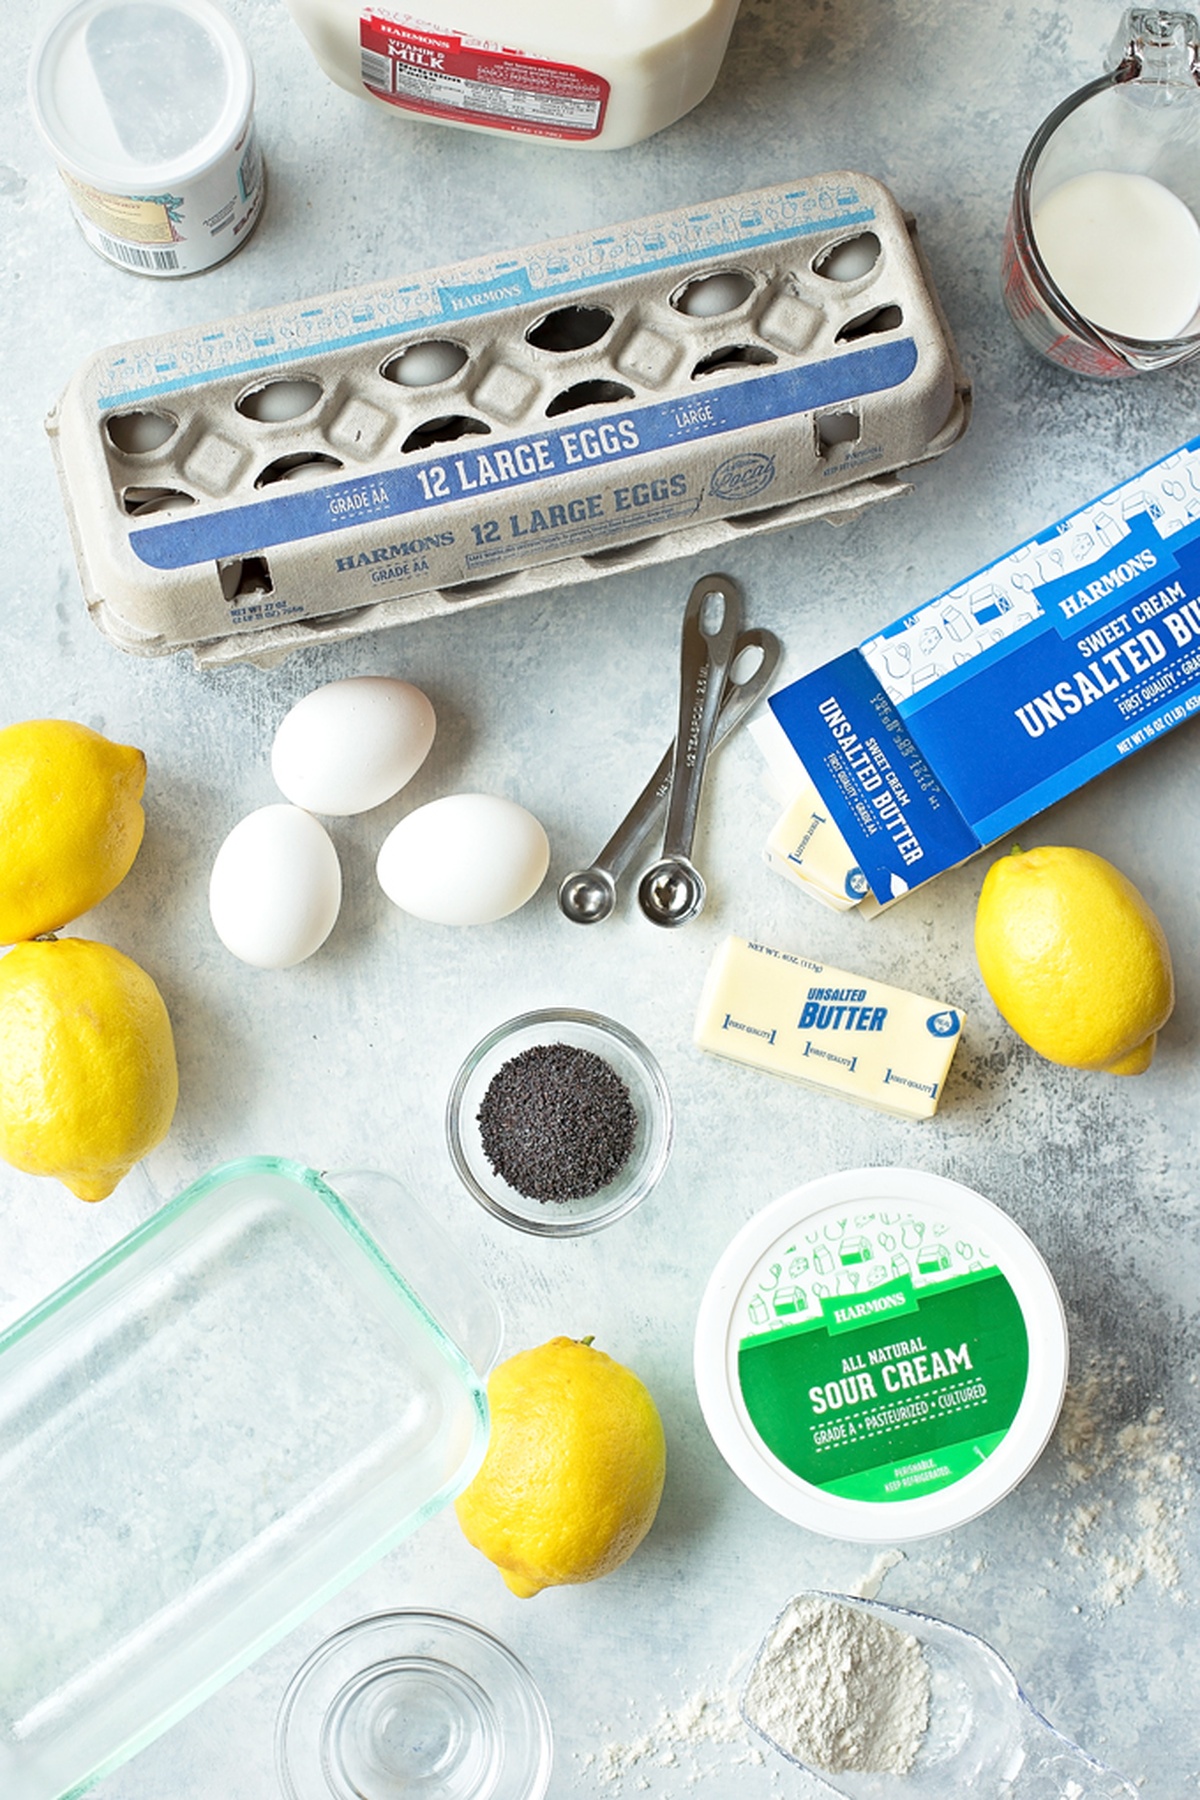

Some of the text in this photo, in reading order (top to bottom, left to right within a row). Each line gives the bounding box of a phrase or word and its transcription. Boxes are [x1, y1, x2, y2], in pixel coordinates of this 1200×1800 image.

[380, 24, 450, 49] HARMONS
[388, 38, 434, 57] VITAMIN
[388, 45, 445, 71] MILK
[451, 284, 522, 312] HARMONS
[675, 404, 714, 428] LARGE
[416, 419, 641, 500] 12 LARGE EGGS
[329, 487, 390, 516] GRADE AA
[335, 531, 456, 573] HARMONS
[470, 520, 501, 546] 12
[509, 494, 604, 538] LARGE
[613, 473, 688, 512] EGGS
[372, 559, 430, 583] GRADE AA
[1058, 548, 1158, 620] HARMONS
[1077, 581, 1187, 658] SWEET CREAM
[1014, 628, 1168, 739] UNSALTED
[1118, 692, 1143, 715] FIRST
[1141, 671, 1177, 701] QUALITY
[1116, 737, 1134, 755] NET
[1130, 729, 1146, 746] WT
[1152, 717, 1166, 732] OZ
[818, 696, 924, 866] UNSALTED BUTTER
[827, 752, 843, 771] FIRST
[837, 770, 858, 799] QUALITY
[865, 737, 912, 808] SWEET CREAM
[807, 987, 867, 1003] UNSALTED
[797, 1001, 888, 1032] BUTTER
[833, 1292, 906, 1324] HARMONS
[841, 1337, 927, 1374] ALL NATURAL
[808, 1343, 973, 1415] SOUR CREAM
[813, 1383, 987, 1445] GRADE A PASTEURIZED CULTURED
[884, 1482, 901, 1493] KEEP
